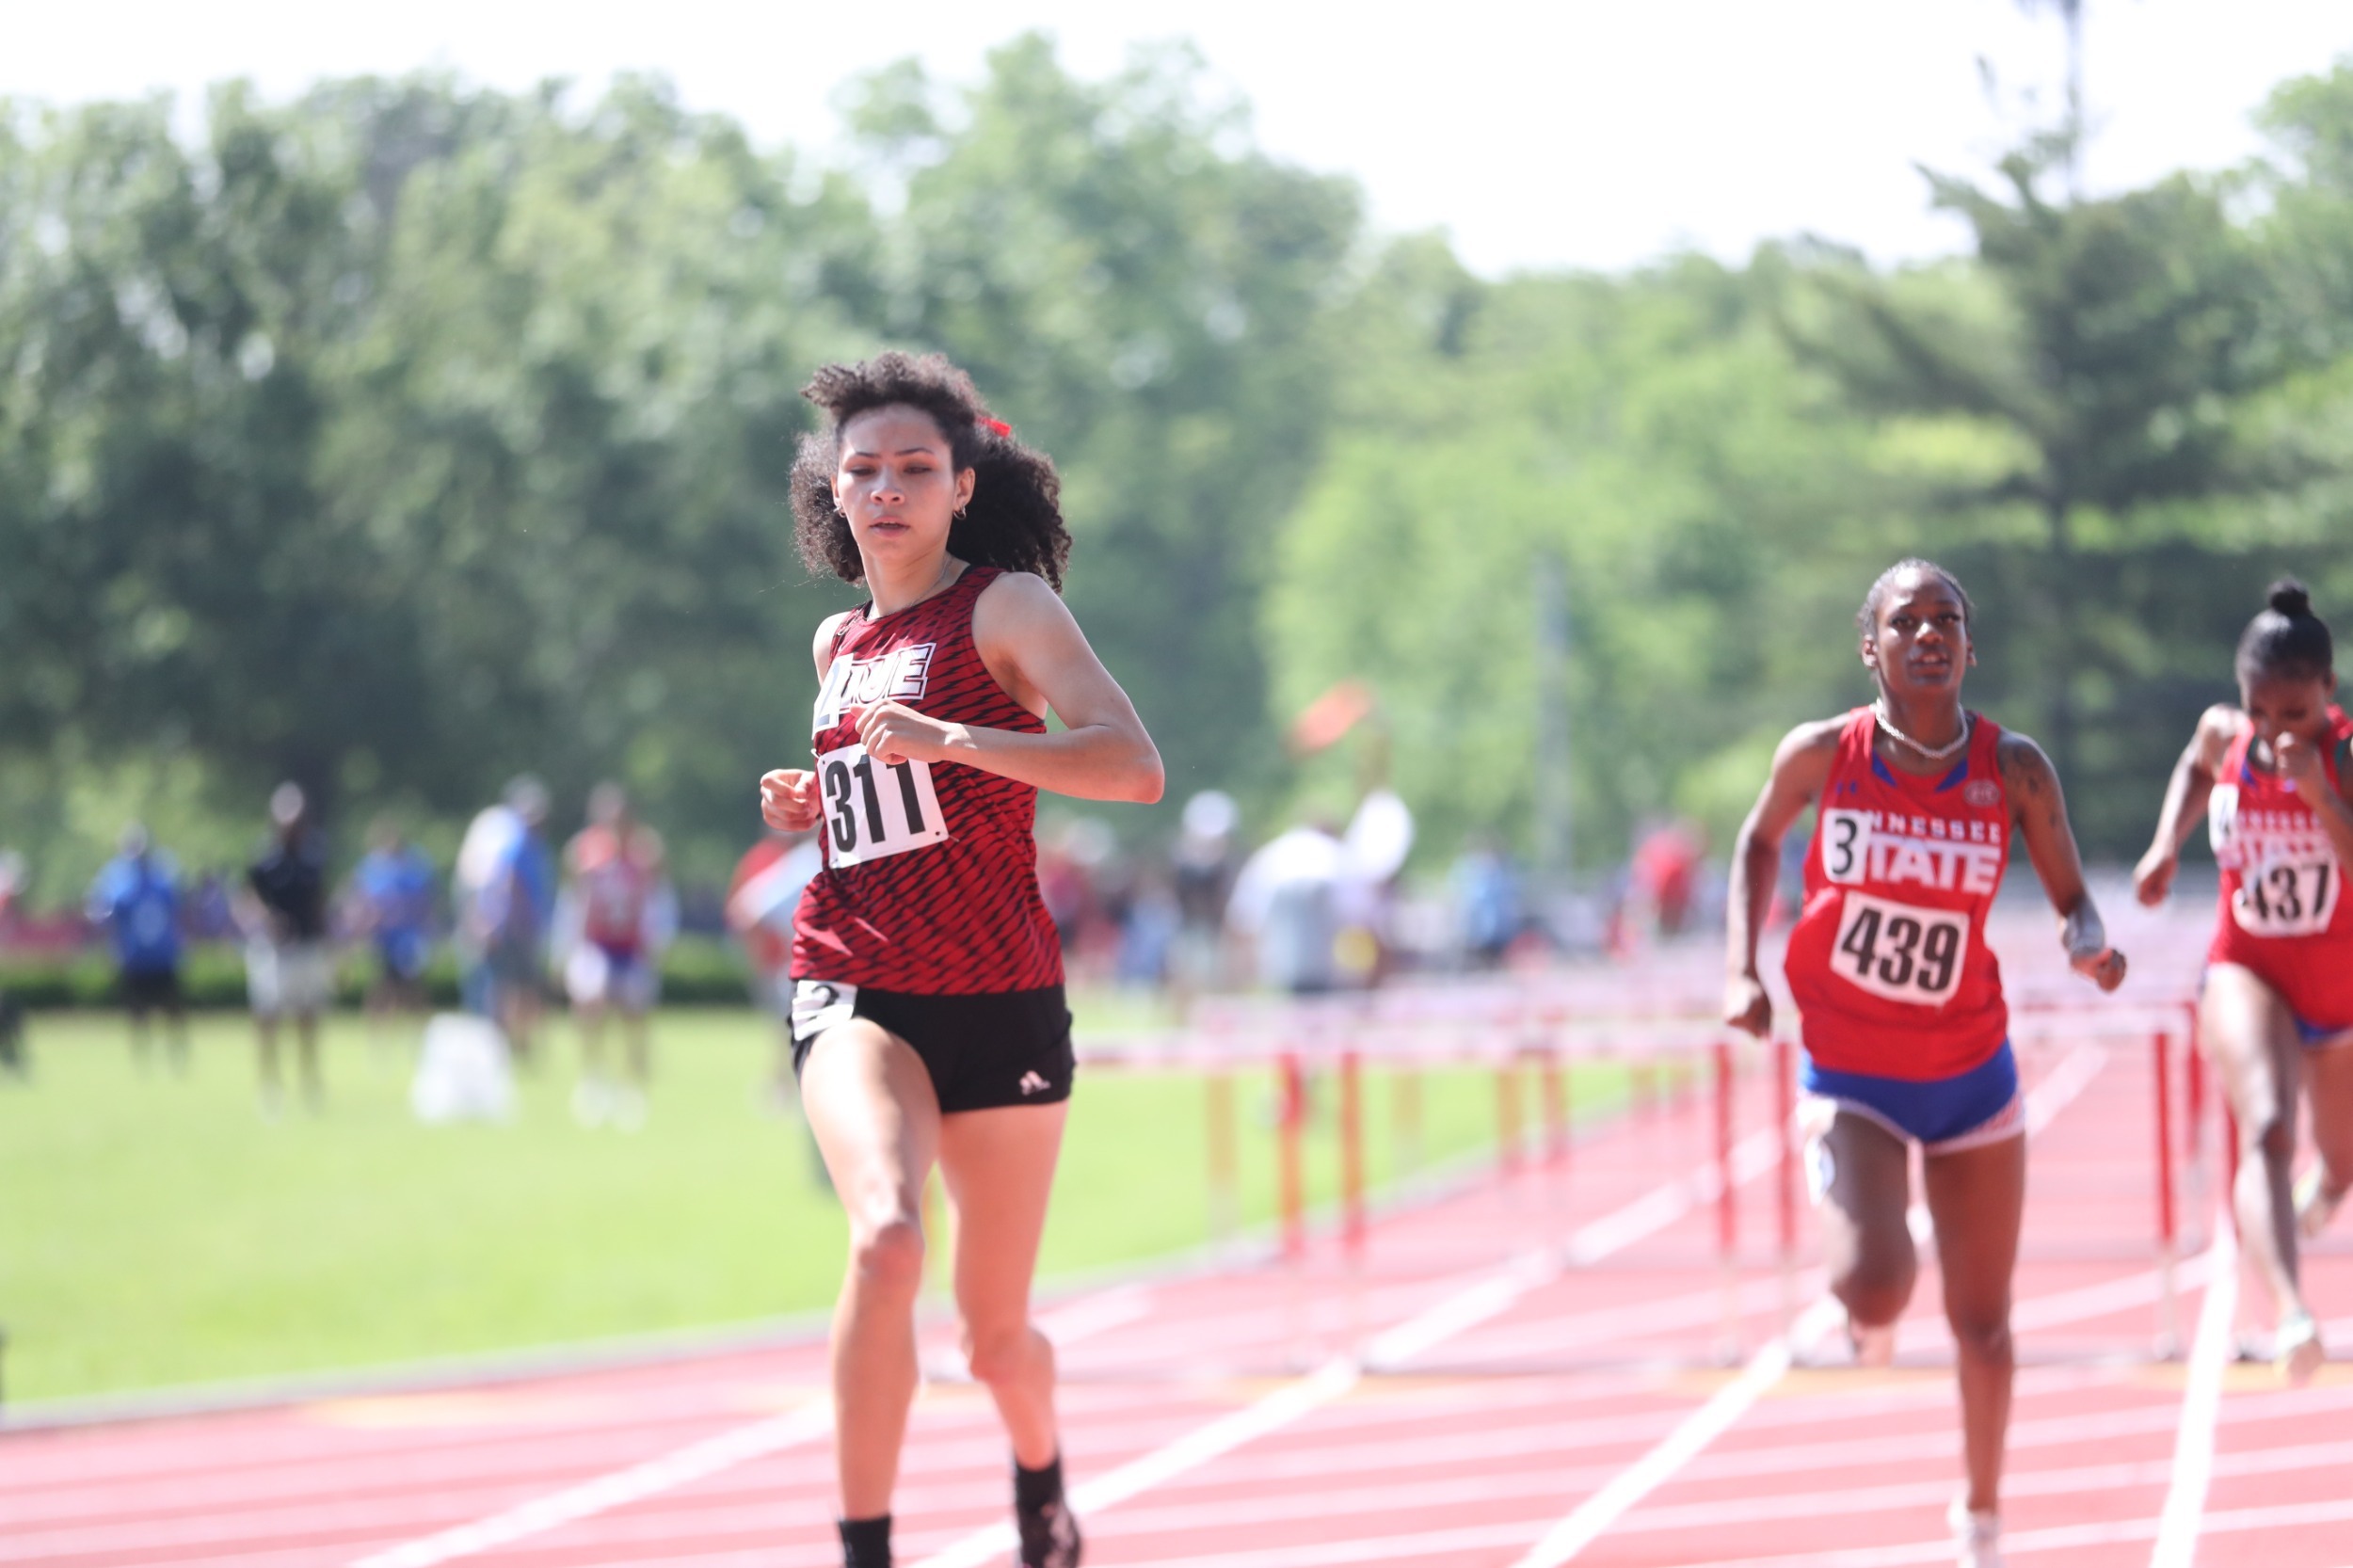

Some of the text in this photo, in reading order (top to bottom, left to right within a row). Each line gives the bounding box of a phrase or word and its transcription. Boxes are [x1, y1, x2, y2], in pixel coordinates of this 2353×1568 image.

[824, 754, 925, 852] 311
[1832, 817, 1858, 875] 3
[1866, 832, 2001, 895] TATE
[1841, 907, 1960, 992] 439
